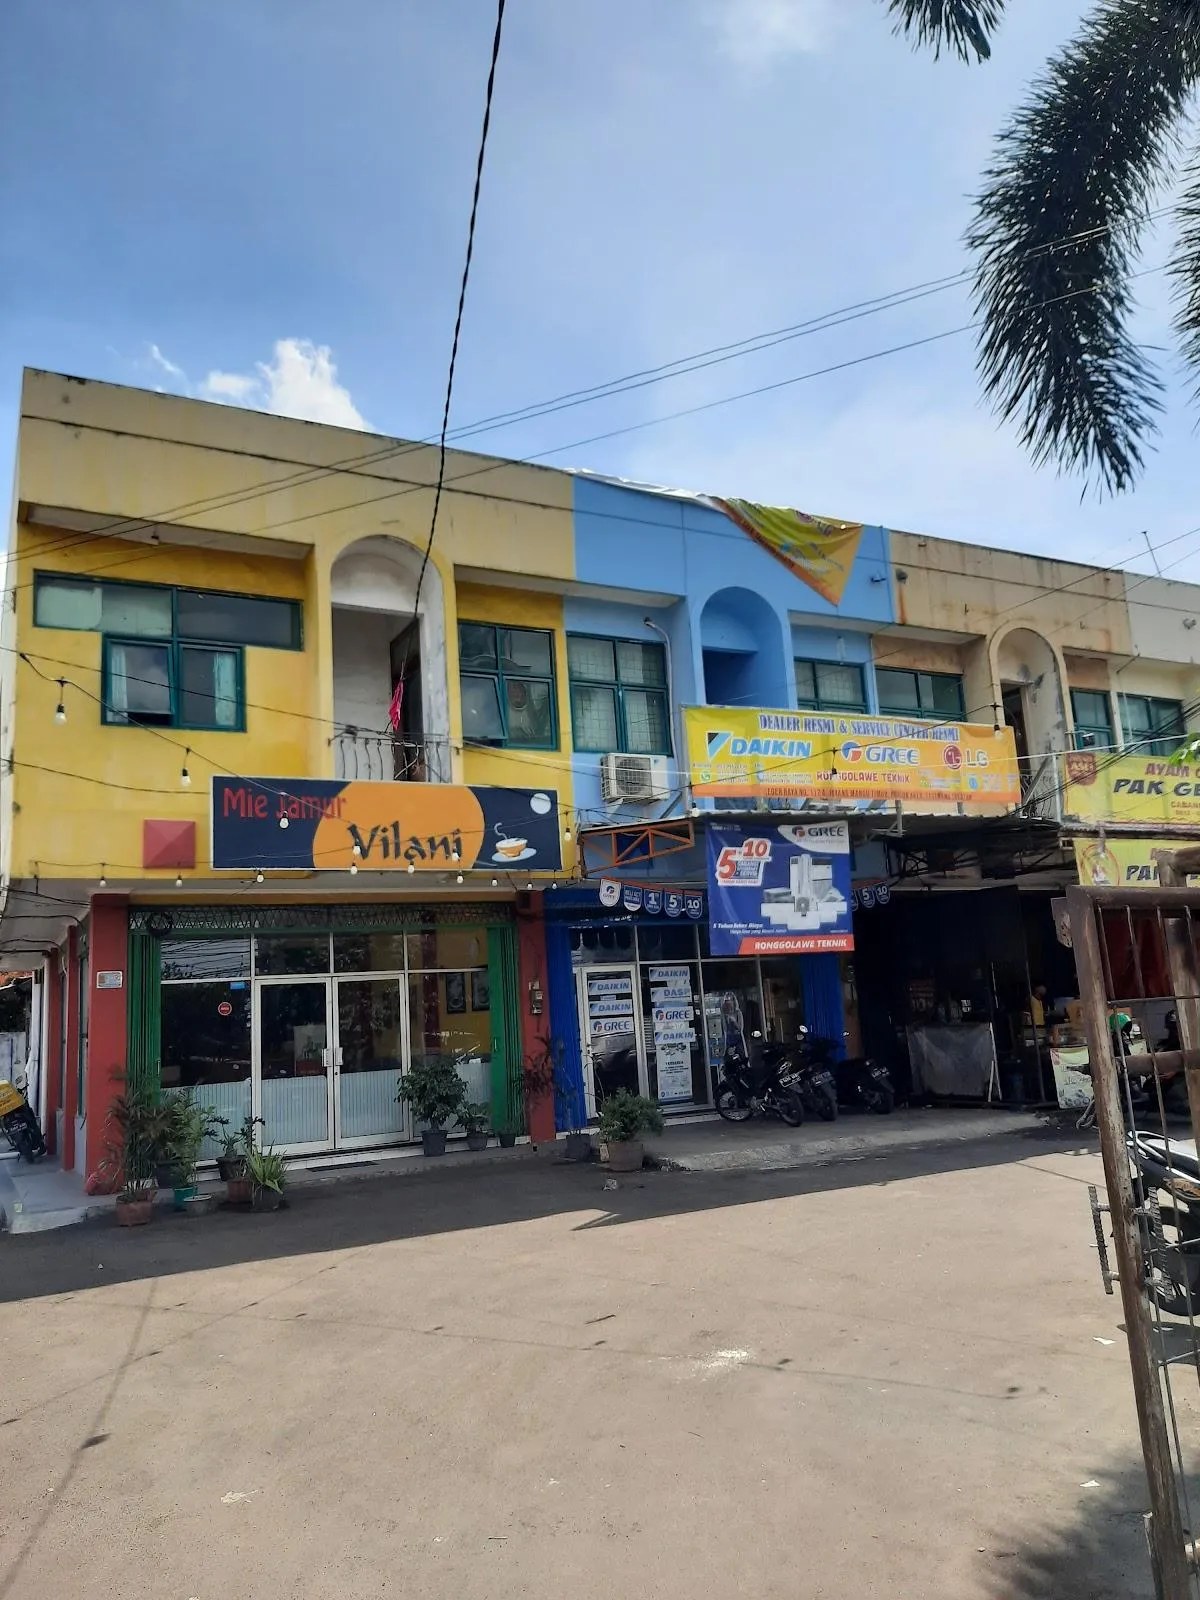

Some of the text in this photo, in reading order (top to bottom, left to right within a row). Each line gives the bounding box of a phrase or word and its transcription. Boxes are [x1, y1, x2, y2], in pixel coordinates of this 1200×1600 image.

[759, 714, 801, 732] DEALER
[803, 716, 836, 735] RESMI
[839, 719, 848, 734] &
[851, 720, 891, 738] SERVICE
[730, 738, 812, 758] DAIKIN
[865, 745, 920, 766] GREE
[966, 749, 989, 767] LG
[1145, 763, 1190, 777] AYAM
[816, 771, 879, 782] ROGOLAWE
[881, 773, 911, 783] TEKNIK
[1113, 779, 1165, 795] PAK
[223, 787, 269, 819] Mie
[275, 795, 347, 820] Jamur
[807, 826, 845, 837] GREE
[347, 820, 462, 861] Vilani
[742, 840, 768, 857] 10
[718, 849, 737, 879] 5
[862, 888, 870, 900] 5
[877, 886, 888, 896] 10
[648, 893, 657, 905] 1
[669, 894, 677, 908] 5
[687, 900, 700, 909] 10
[754, 938, 847, 951] RONGGOLAWE TEKNIK
[658, 969, 689, 978] DAIKIN
[596, 981, 630, 991] DAIKIN
[598, 1003, 631, 1012] DAIKIN
[665, 1010, 691, 1020] GREE
[604, 1020, 630, 1032] GREE
[663, 1031, 694, 1041] DAIKIN
